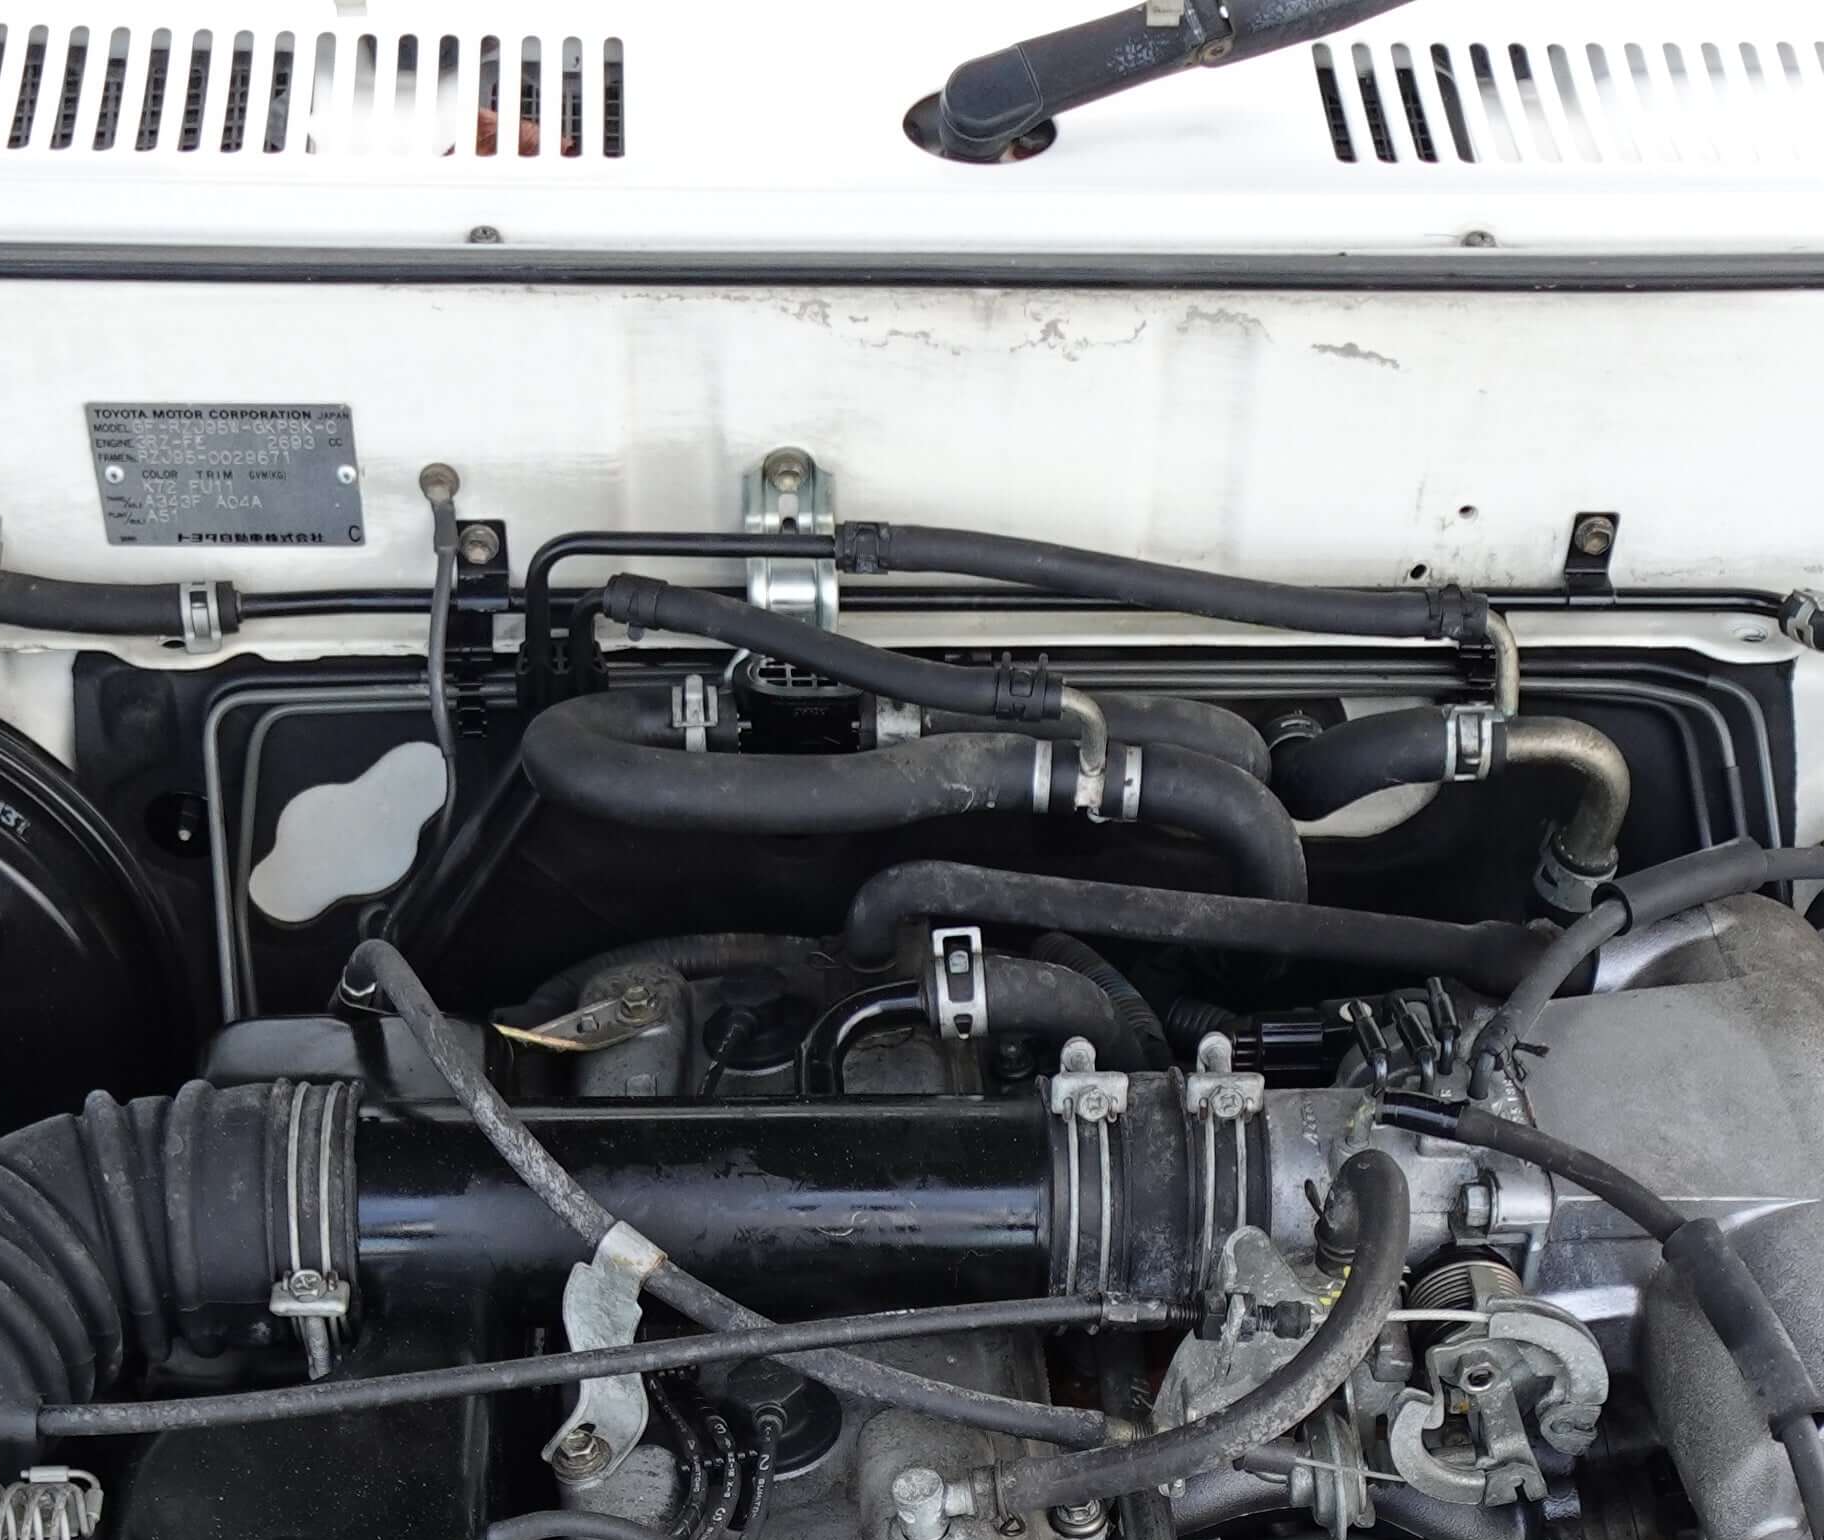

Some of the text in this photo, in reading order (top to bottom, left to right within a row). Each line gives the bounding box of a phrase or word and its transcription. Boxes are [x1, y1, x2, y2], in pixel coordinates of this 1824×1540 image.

[94, 409, 349, 420] TOYOTA MOTOR CORPORATION JAPAN
[94, 424, 129, 433] MODEL
[135, 436, 206, 449] 3RZ-FE
[142, 470, 178, 480] COLOR
[196, 470, 233, 480] TRIM
[177, 532, 325, 543] トヨタ自動車株式会社
[349, 526, 361, 542] C
